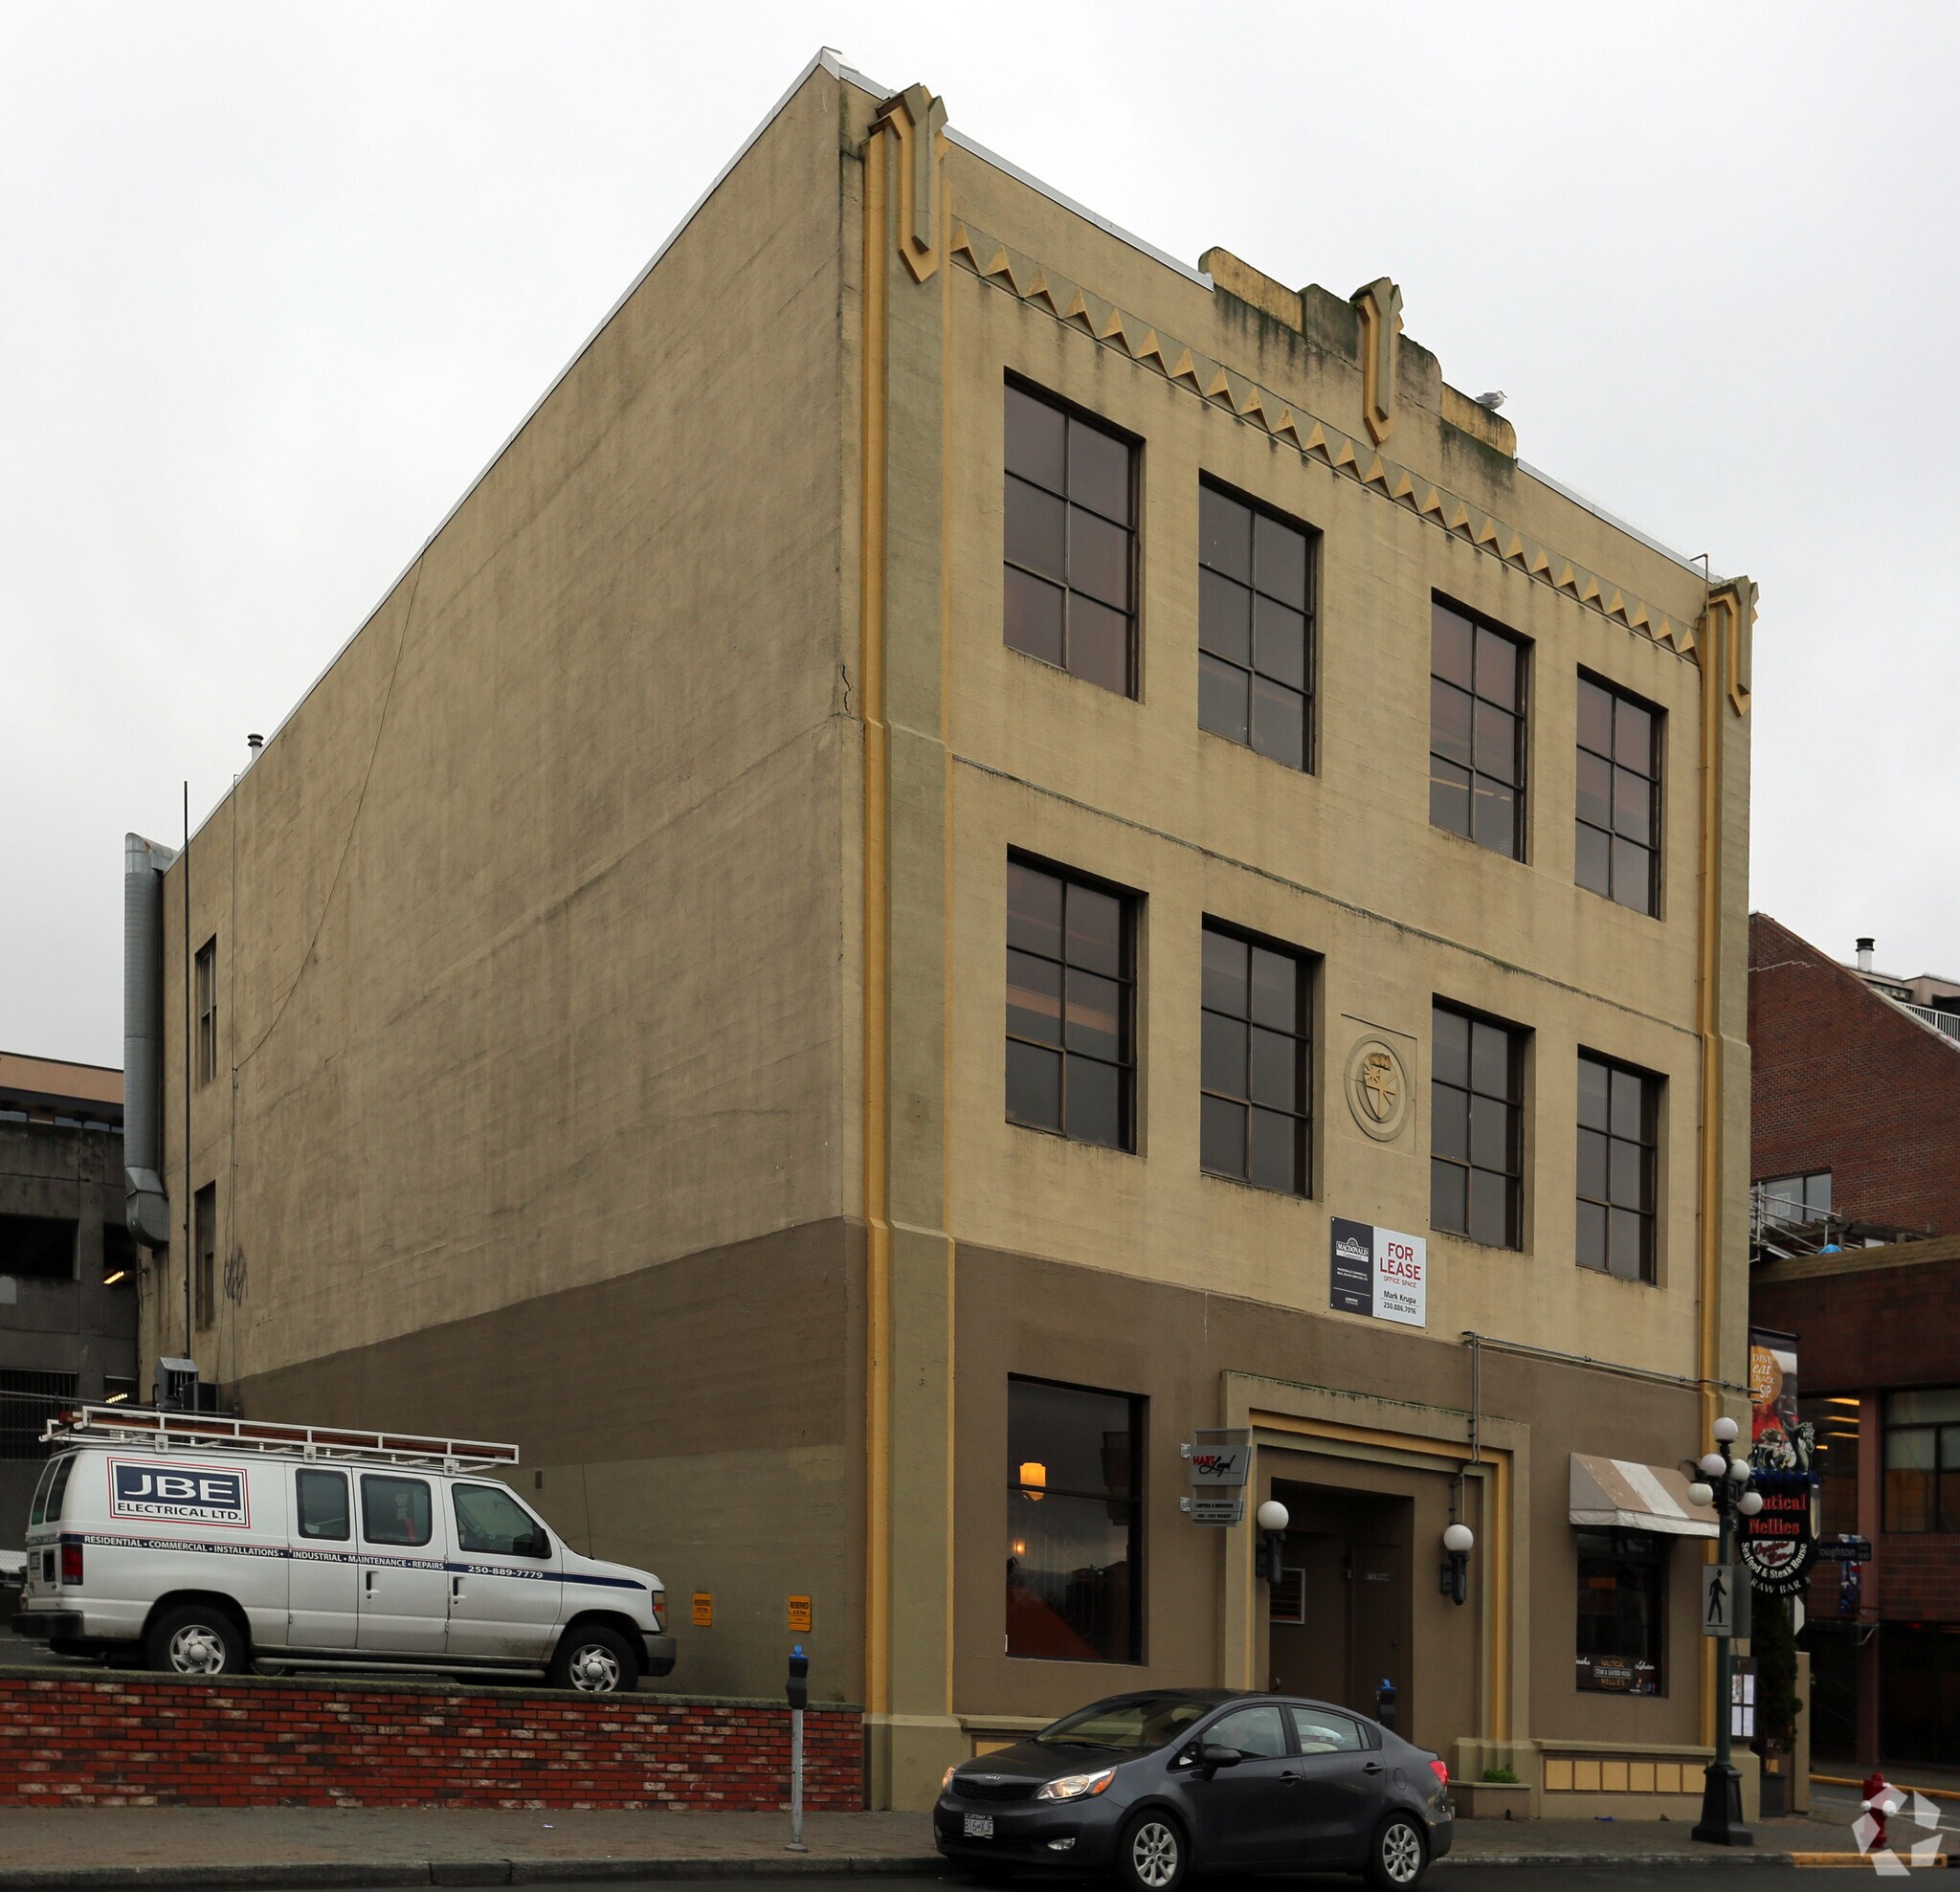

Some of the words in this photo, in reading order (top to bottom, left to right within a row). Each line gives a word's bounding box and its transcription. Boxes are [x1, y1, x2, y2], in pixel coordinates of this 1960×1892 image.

[1337, 1243, 1369, 1256] MACDONALD
[1388, 1242, 1414, 1262] FOR
[1379, 1258, 1421, 1280] LEASE
[1383, 1276, 1400, 1285] OFFICE
[1401, 1280, 1417, 1289] SPACE
[1383, 1290, 1398, 1300] Mark
[1399, 1293, 1416, 1304] Krupa
[1752, 1364, 1771, 1375] eat
[1760, 1384, 1771, 1399] SIP
[1193, 1455, 1215, 1465] HART
[123, 1474, 235, 1503] JBE
[1762, 1494, 1807, 1511] utical
[118, 1502, 208, 1518] ELECTRICAL
[212, 1510, 242, 1521] LTD.
[1748, 1518, 1800, 1535] Nellies
[84, 1535, 143, 1547] RESIDENTIAL
[148, 1540, 208, 1552] COMMERCIAL
[213, 1545, 278, 1557] INSTALLATIONS
[292, 1550, 343, 1562] INDUSTRIAL
[347, 1554, 407, 1568] MAINTENANCE
[412, 1560, 444, 1570] REPAIRS
[467, 1565, 544, 1579] 250-889-7779
[1818, 1547, 1856, 1558] roughton
[1741, 1542, 1762, 1574] Seafood
[1761, 1568, 1769, 1578] &
[1770, 1565, 1793, 1579] Steak
[1791, 1543, 1808, 1569] House
[1750, 1578, 1775, 1593] RAW
[1779, 1579, 1802, 1593] BAR
[790, 1601, 809, 1610] RESERVED
